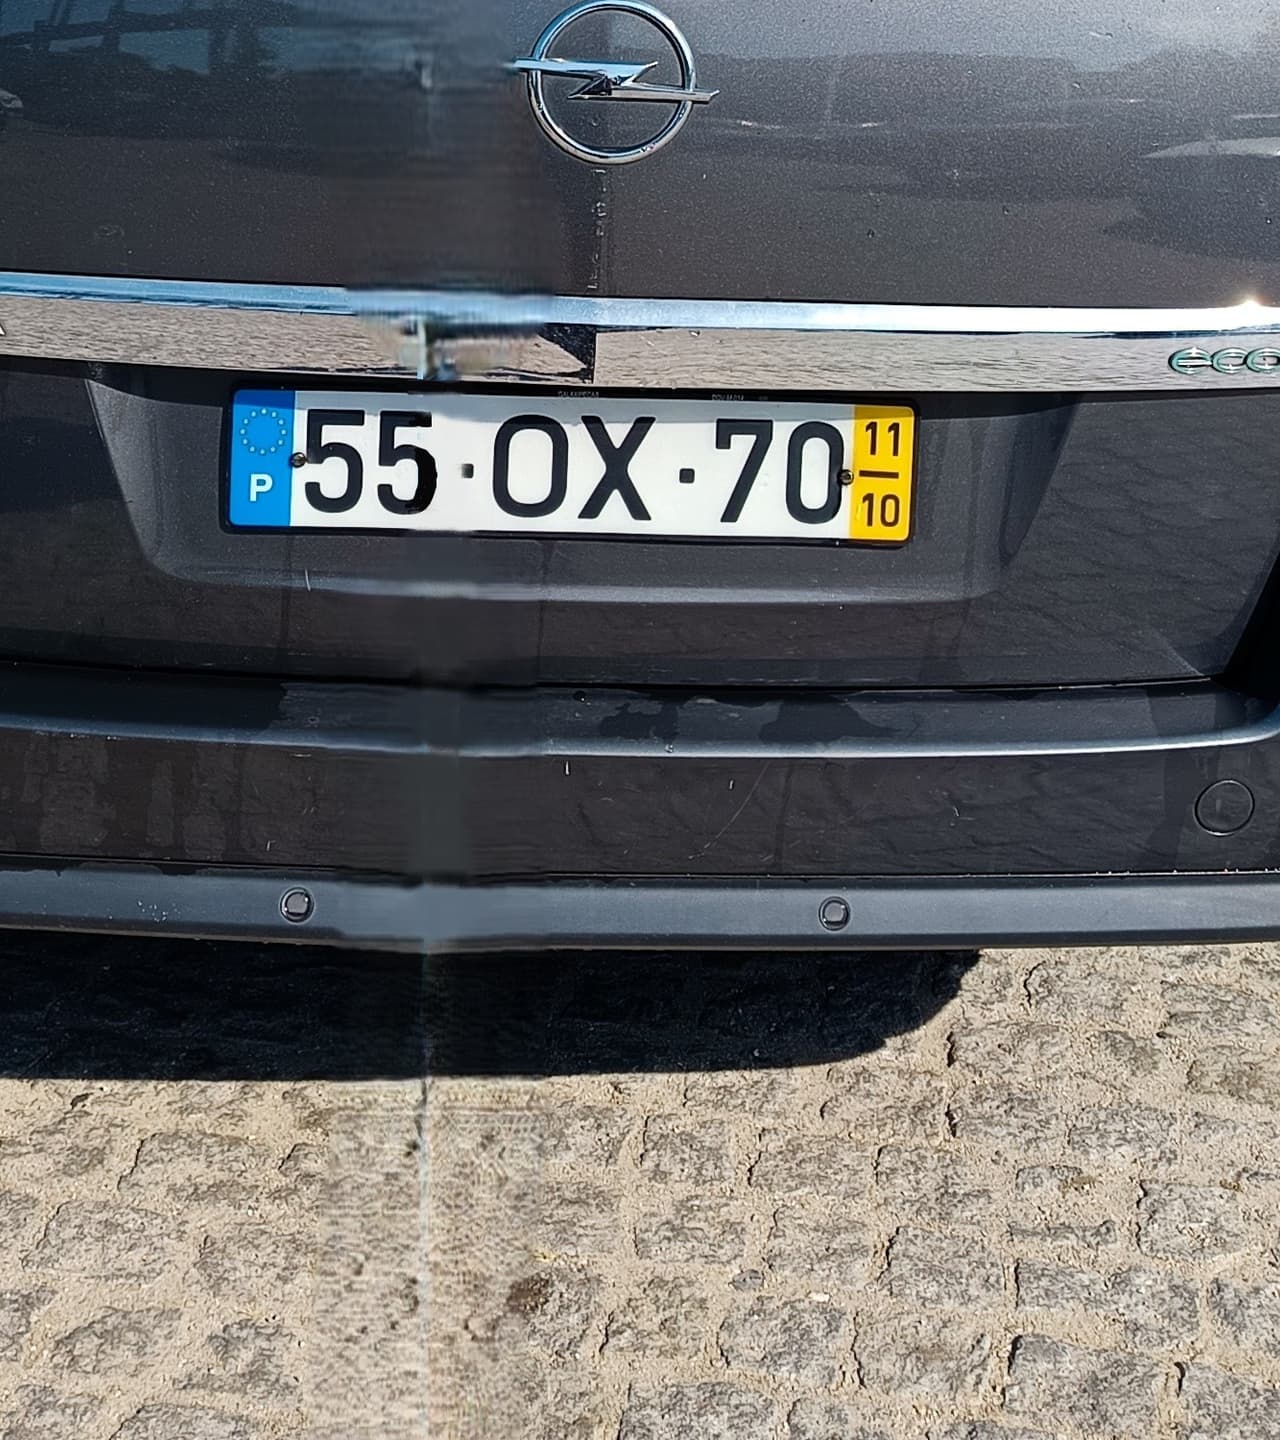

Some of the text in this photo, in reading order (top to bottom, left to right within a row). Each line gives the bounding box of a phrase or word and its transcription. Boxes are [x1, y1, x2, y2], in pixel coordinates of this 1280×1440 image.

[865, 421, 900, 457] 11
[249, 473, 273, 502] P
[862, 492, 900, 528] 10
